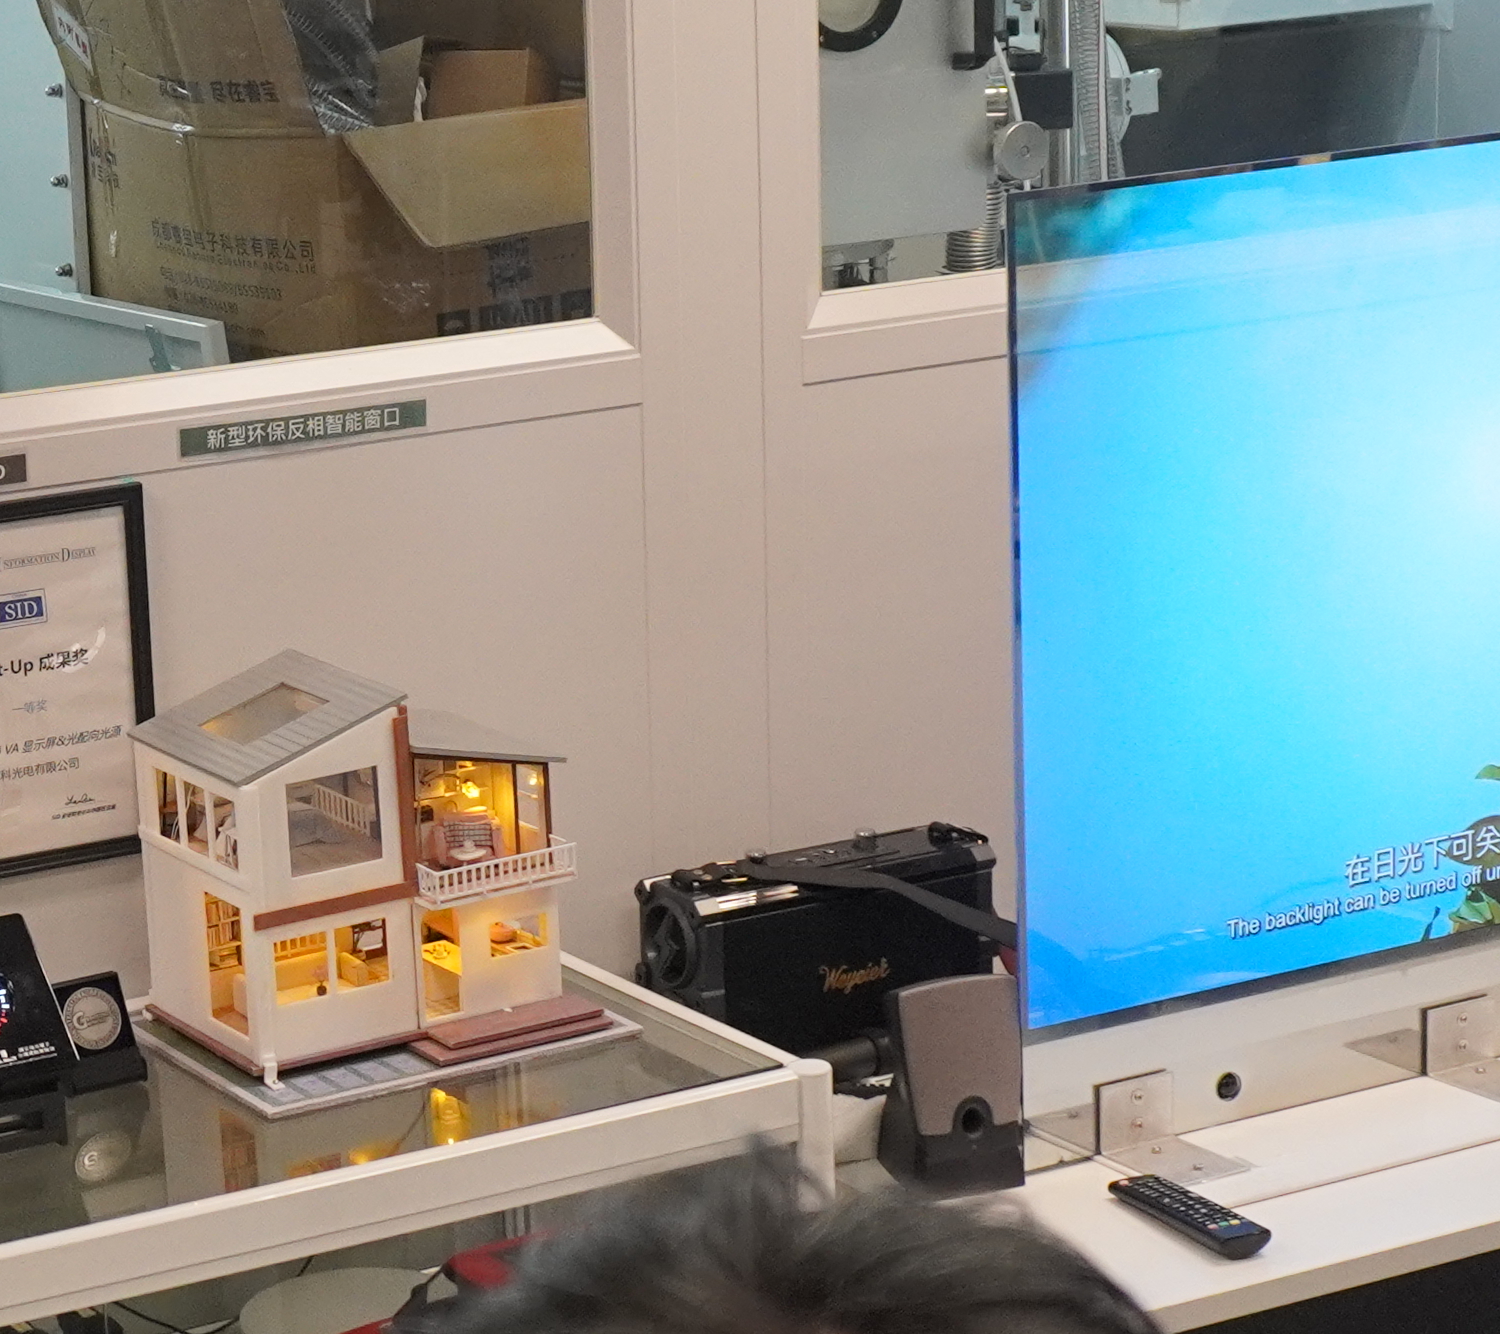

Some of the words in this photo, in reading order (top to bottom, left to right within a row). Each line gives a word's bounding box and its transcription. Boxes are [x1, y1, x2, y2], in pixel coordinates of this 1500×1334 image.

[206, 408, 400, 450] 新型环保反相智能窗口
[4, 600, 37, 620] SID
[1227, 918, 1261, 939] The
[1265, 898, 1342, 926] backlight
[1344, 893, 1375, 913] can
[1379, 886, 1401, 907] be
[1405, 871, 1458, 900] turned
[1461, 864, 1483, 887] off
